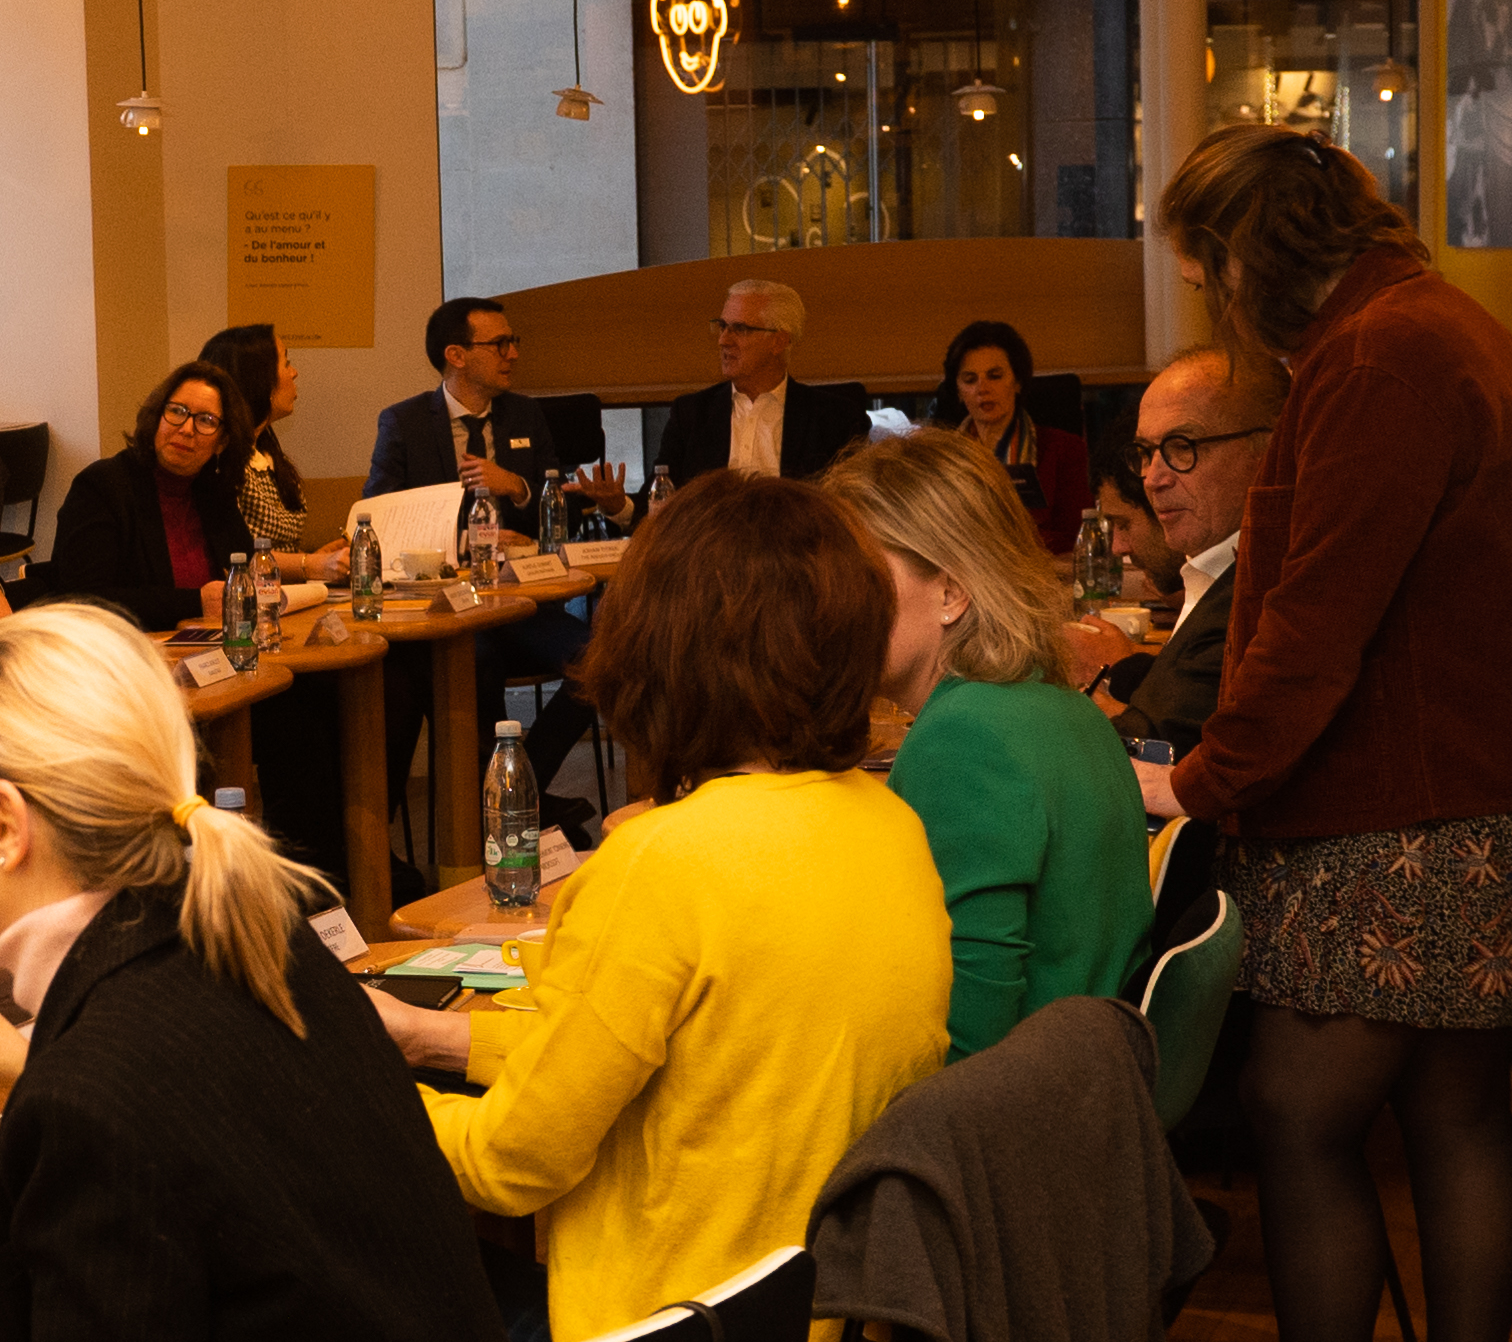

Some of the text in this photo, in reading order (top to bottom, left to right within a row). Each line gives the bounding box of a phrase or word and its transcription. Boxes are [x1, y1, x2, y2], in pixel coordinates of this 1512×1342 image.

[271, 225, 301, 234] menu
[251, 240, 267, 250] De
[270, 240, 311, 250] l'amour
[315, 241, 326, 250] et
[244, 254, 258, 263] du
[261, 253, 307, 264] bonheur
